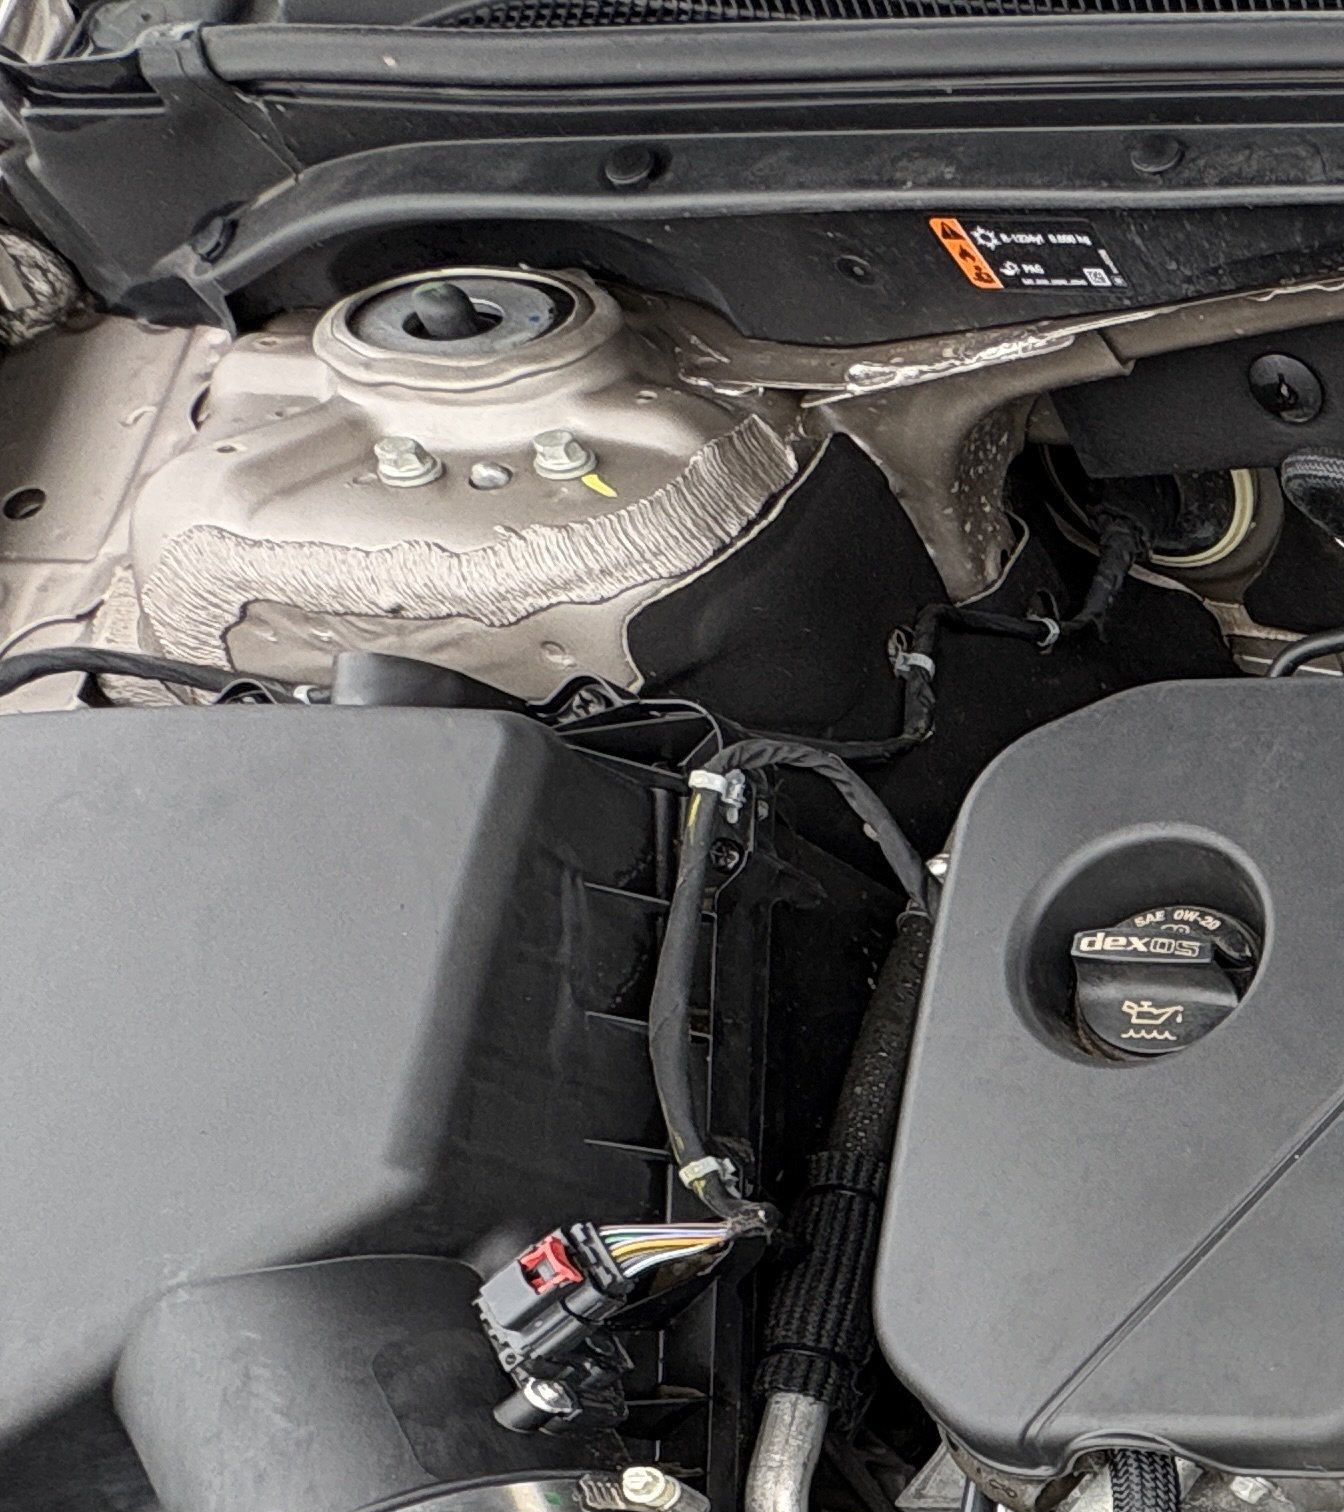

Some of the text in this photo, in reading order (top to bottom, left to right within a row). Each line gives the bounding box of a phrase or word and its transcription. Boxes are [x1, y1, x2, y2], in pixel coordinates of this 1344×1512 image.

[1134, 909, 1222, 931] SAE 0W-20
[1079, 932, 1203, 957] dexos
